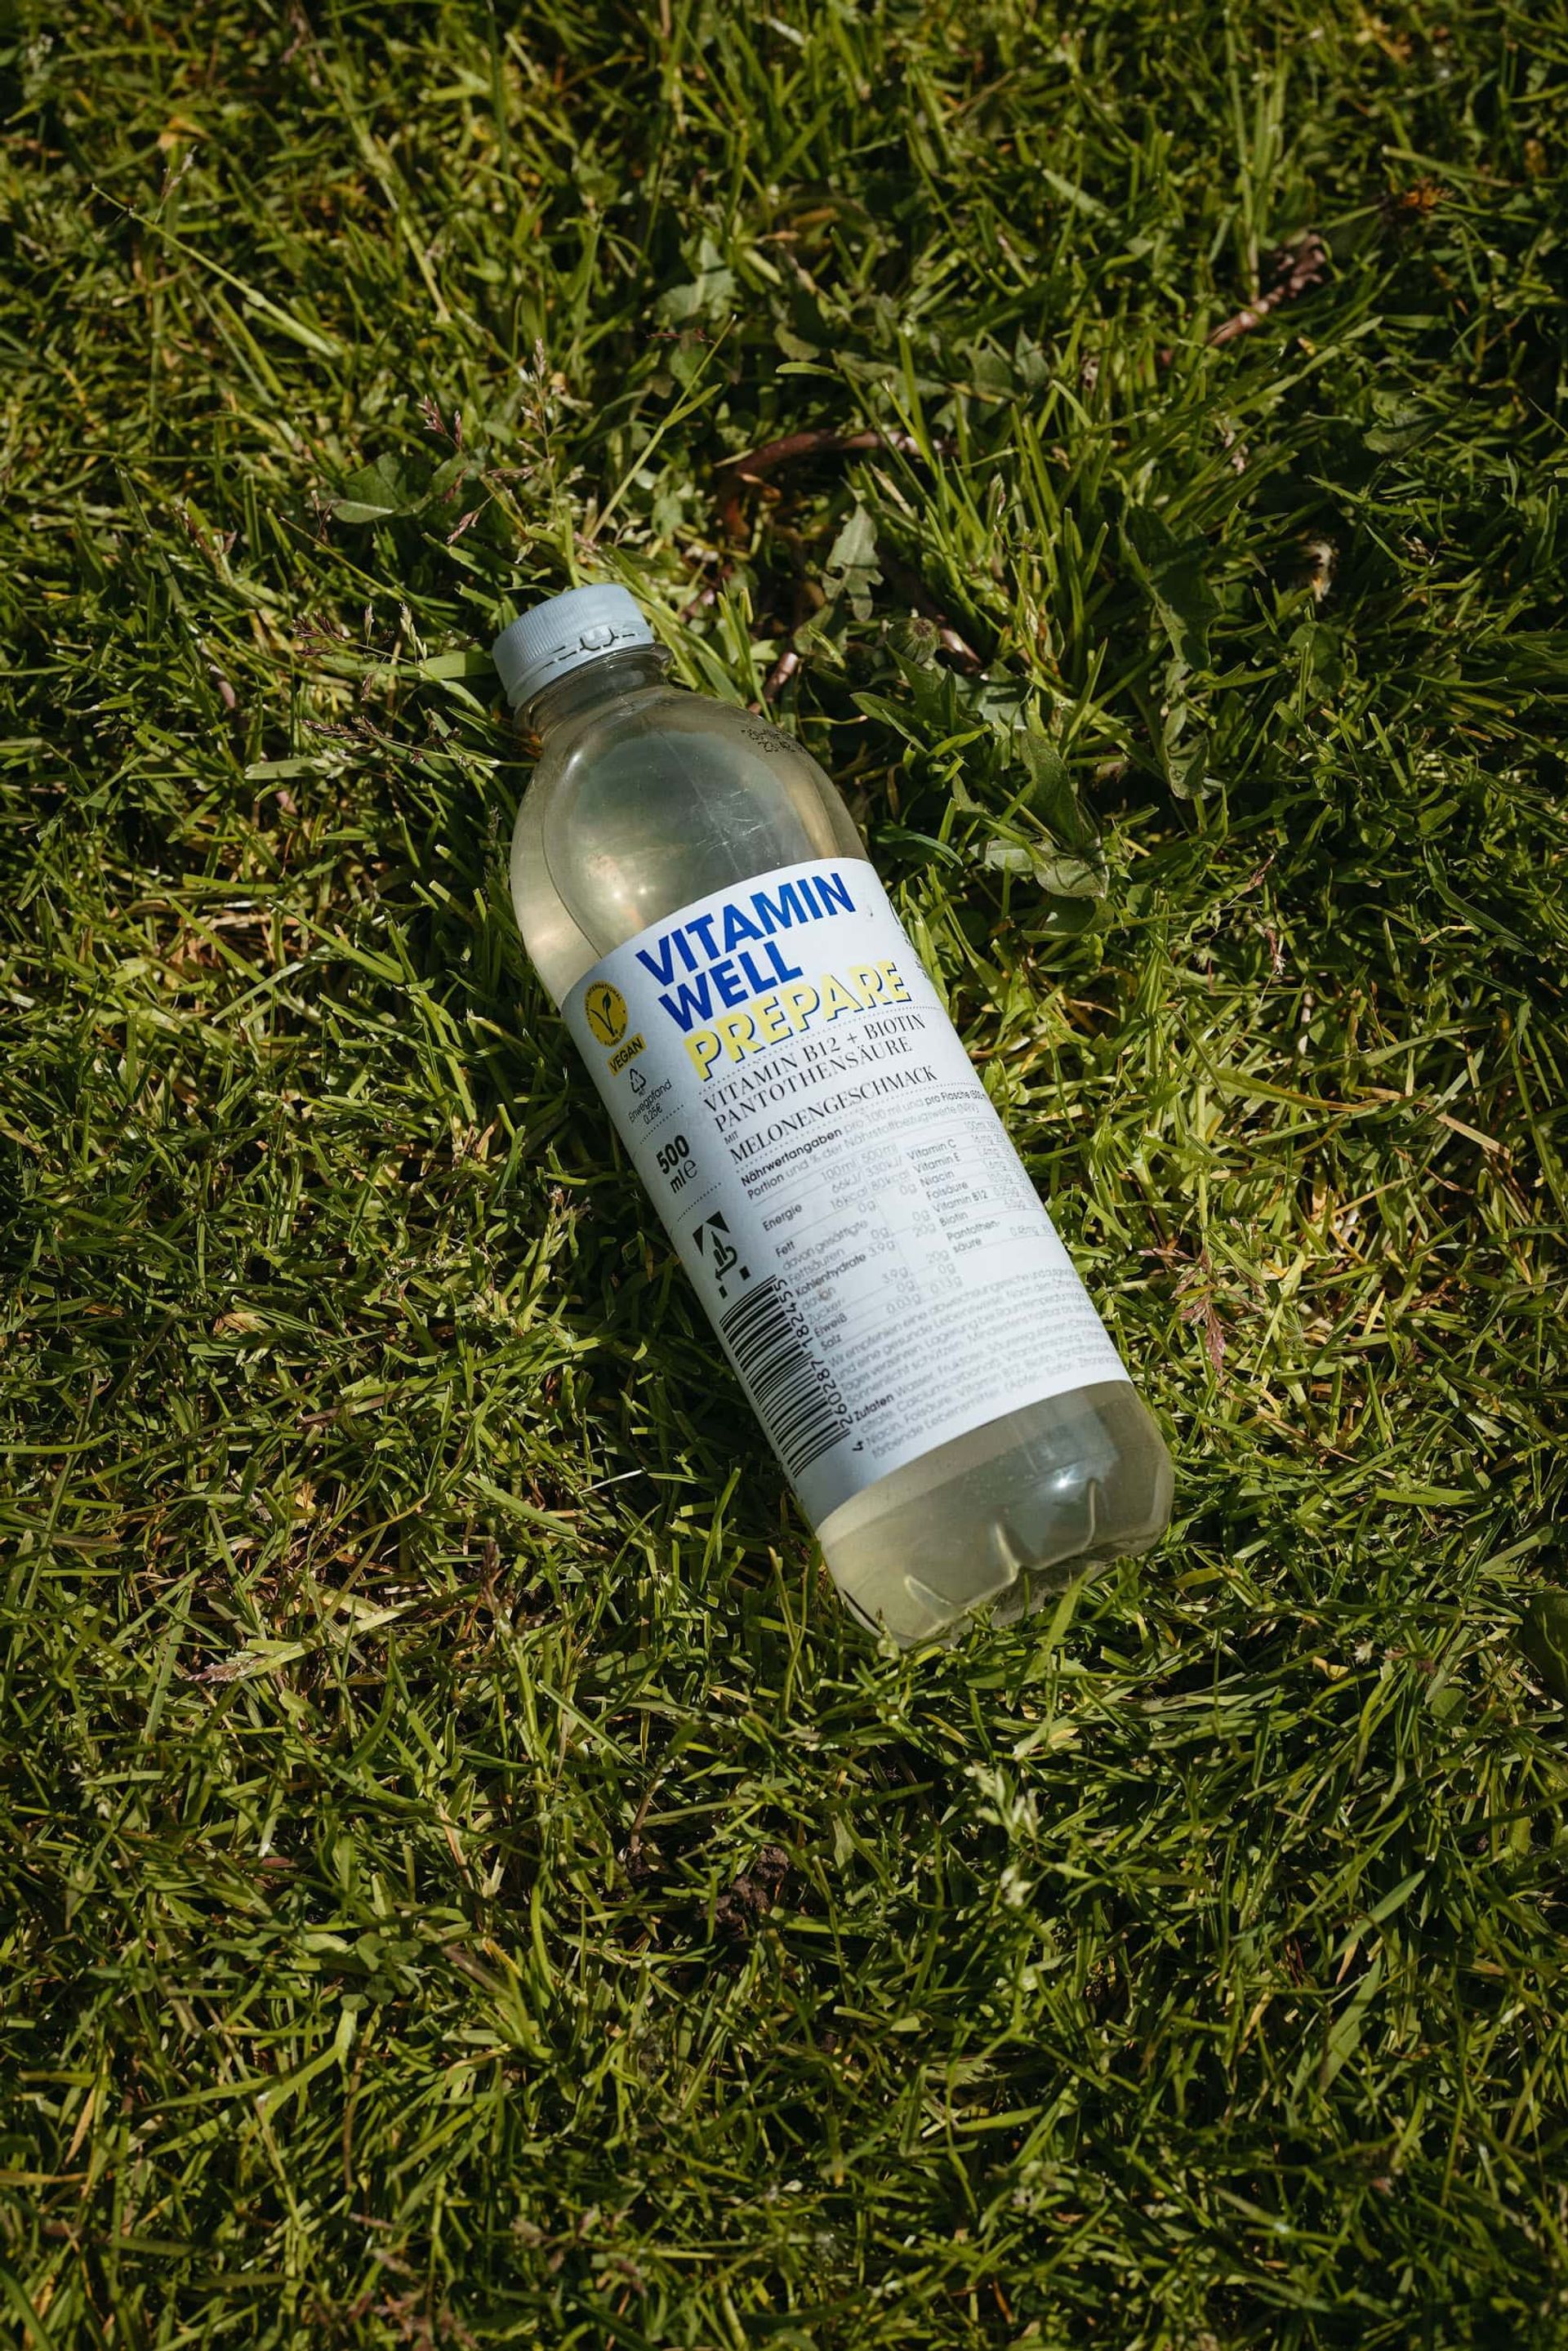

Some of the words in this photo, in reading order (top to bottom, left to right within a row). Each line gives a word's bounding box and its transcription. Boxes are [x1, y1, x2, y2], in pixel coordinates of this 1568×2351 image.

[635, 871, 856, 986] VITAMIN
[657, 941, 803, 1032] WELL
[681, 958, 911, 1082] PREPARE
[609, 1036, 644, 1071] VEGAN
[702, 1052, 798, 1111] VITAMIN
[802, 1035, 841, 1062] B12
[847, 1032, 857, 1043] +
[862, 1013, 925, 1040] BIOTIN
[713, 1035, 911, 1133] PANTOTHENSÄURE
[723, 1129, 739, 1145] MIT
[728, 1064, 938, 1164] MELONENGESCHMACK
[740, 1128, 841, 1187] Nährwertangaben
[924, 1093, 941, 1106] pro
[655, 1134, 690, 1174] 500
[746, 1173, 784, 1200] Portion
[762, 1203, 802, 1231] Energie
[906, 1142, 947, 1158] Vitamin
[946, 1137, 957, 1150] C
[912, 1156, 954, 1173] Vitamin
[952, 1151, 961, 1162] E
[774, 1240, 795, 1258] Fett
[919, 1170, 955, 1187] Niacin
[781, 1247, 814, 1271] davon
[925, 1181, 969, 1201] Folsäure
[931, 1195, 972, 1212] Vitamin
[794, 1253, 866, 1298] Kohlenhydrate
[938, 1211, 969, 1227] Biotin
[774, 1278, 813, 1347] 182455
[819, 1333, 842, 1351] Salz
[810, 1360, 854, 1427] 260287
[853, 1392, 894, 1422] Zutaten
[849, 1438, 866, 1454] 4
